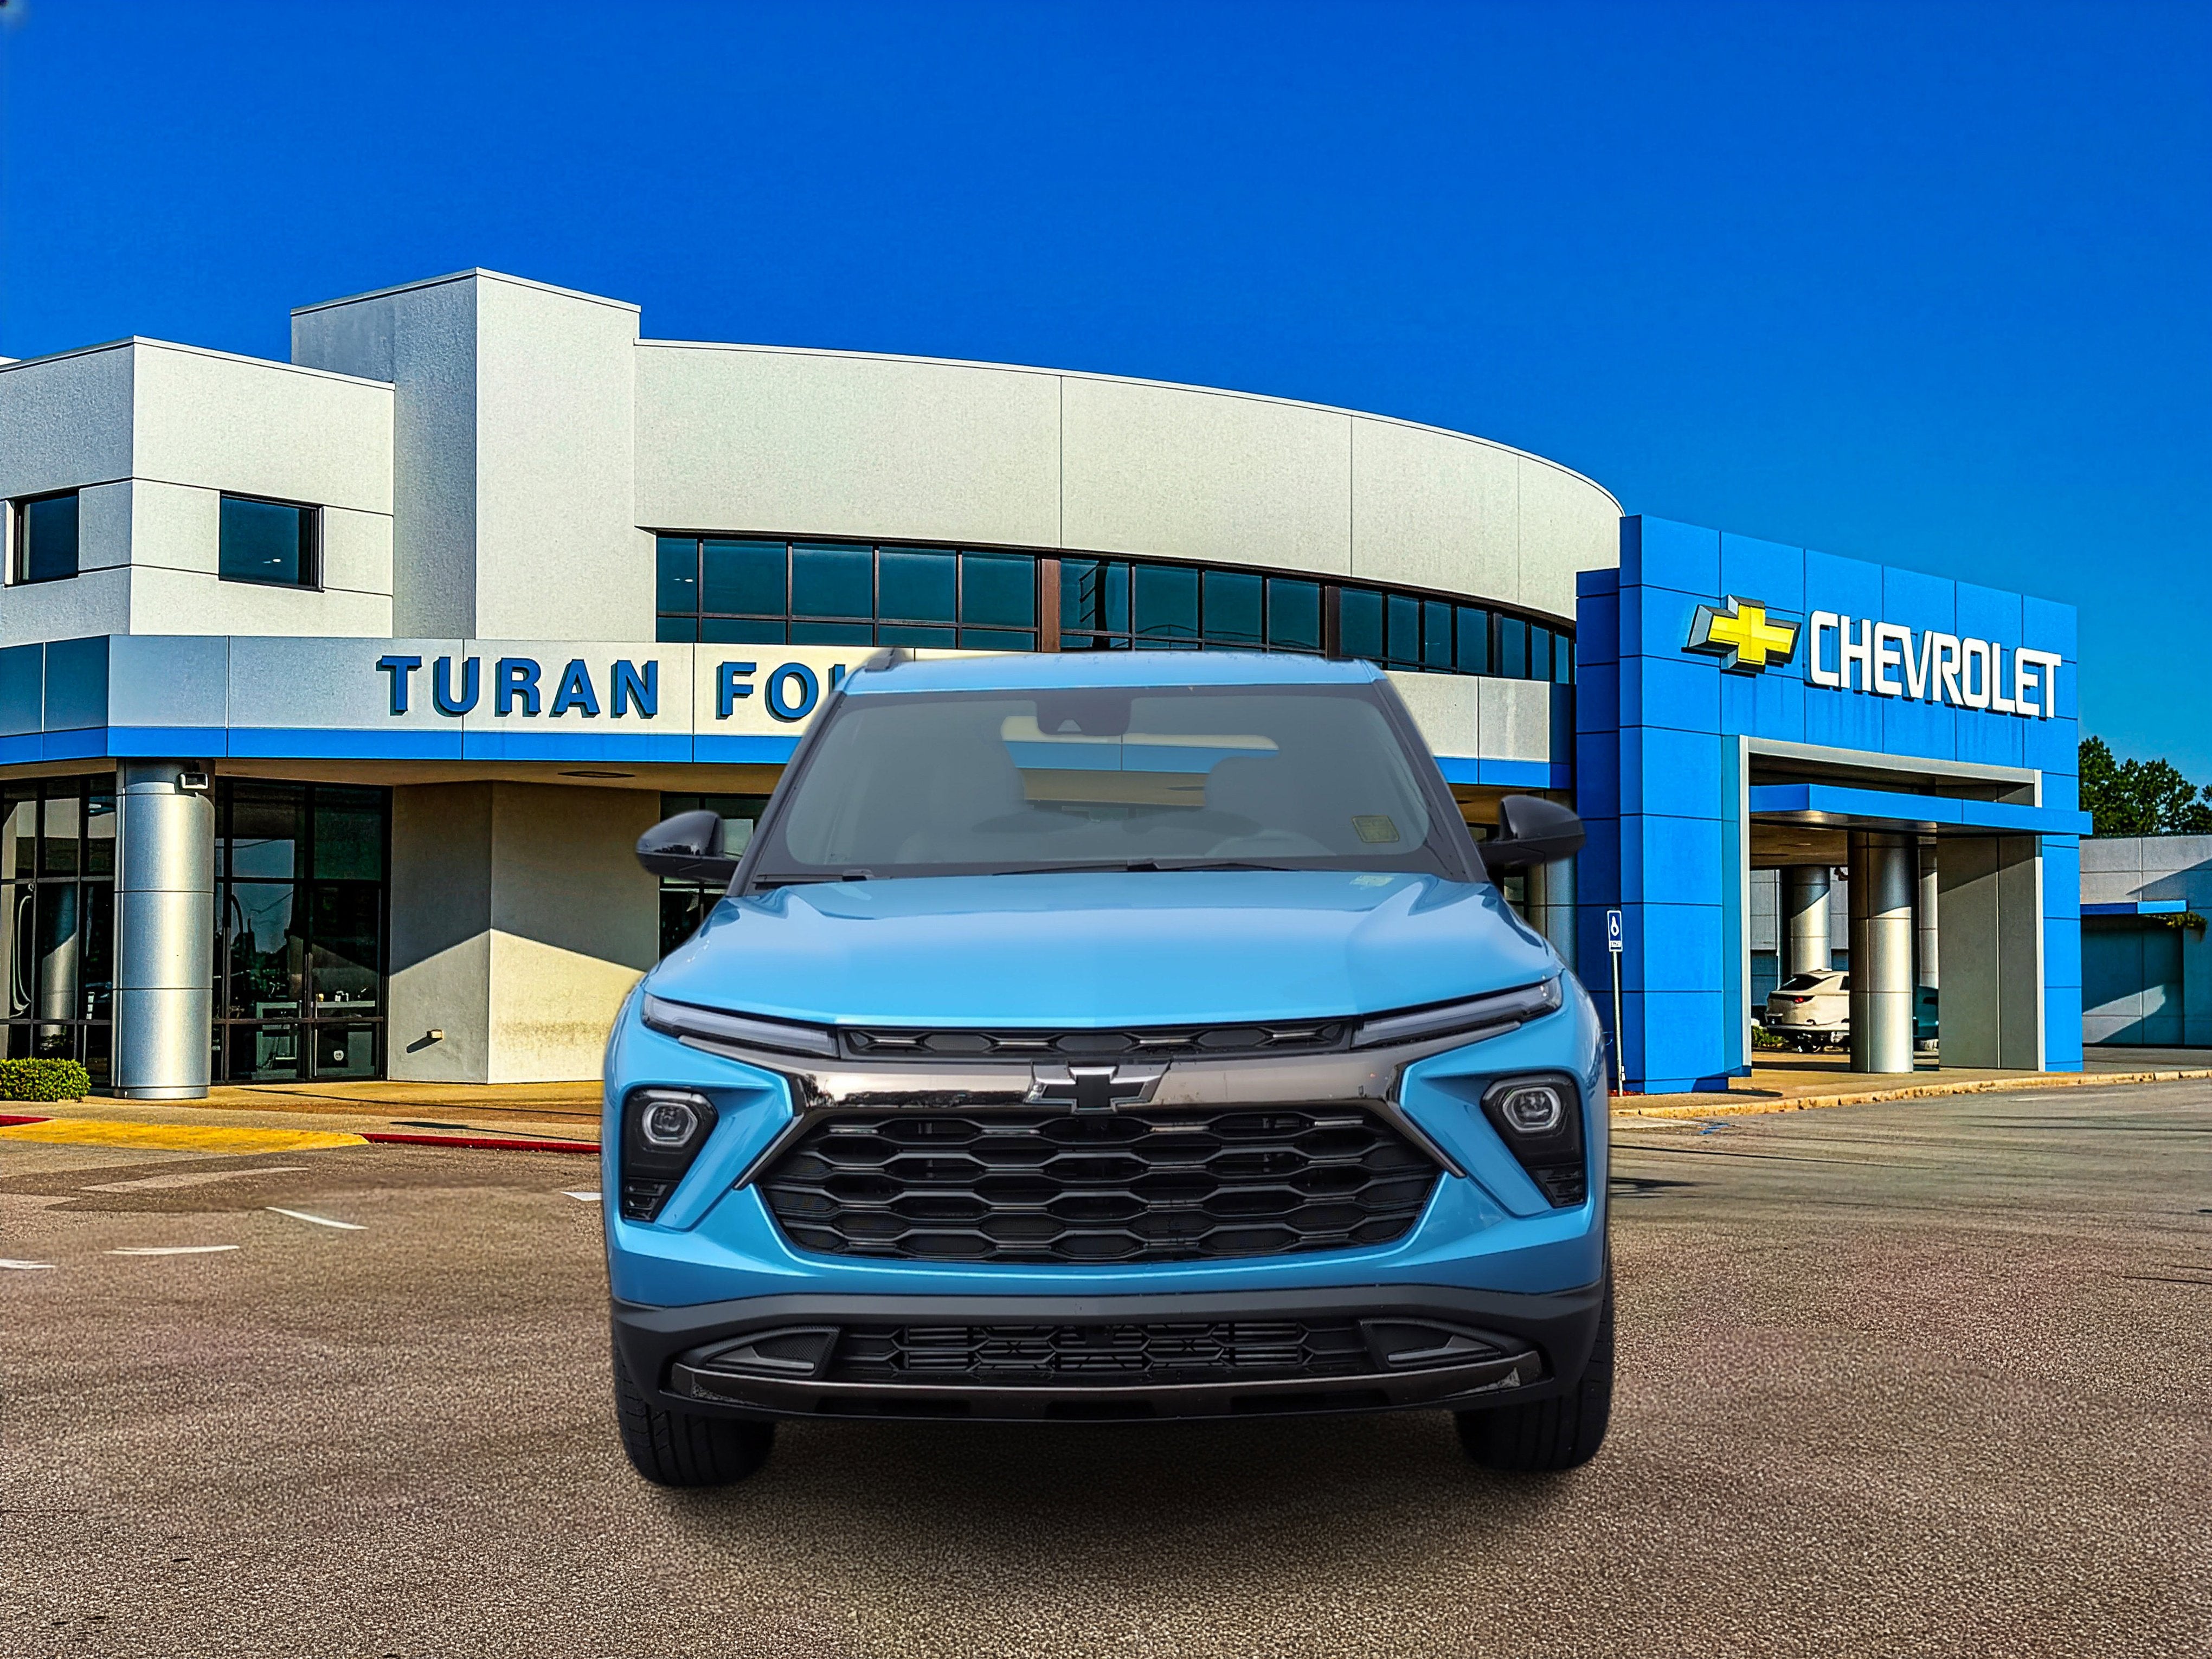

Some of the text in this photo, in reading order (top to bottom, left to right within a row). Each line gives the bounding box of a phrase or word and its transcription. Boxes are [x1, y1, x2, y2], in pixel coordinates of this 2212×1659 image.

[376, 655, 846, 723] TURAN FO
[1809, 610, 2062, 719] CHEVROLET
